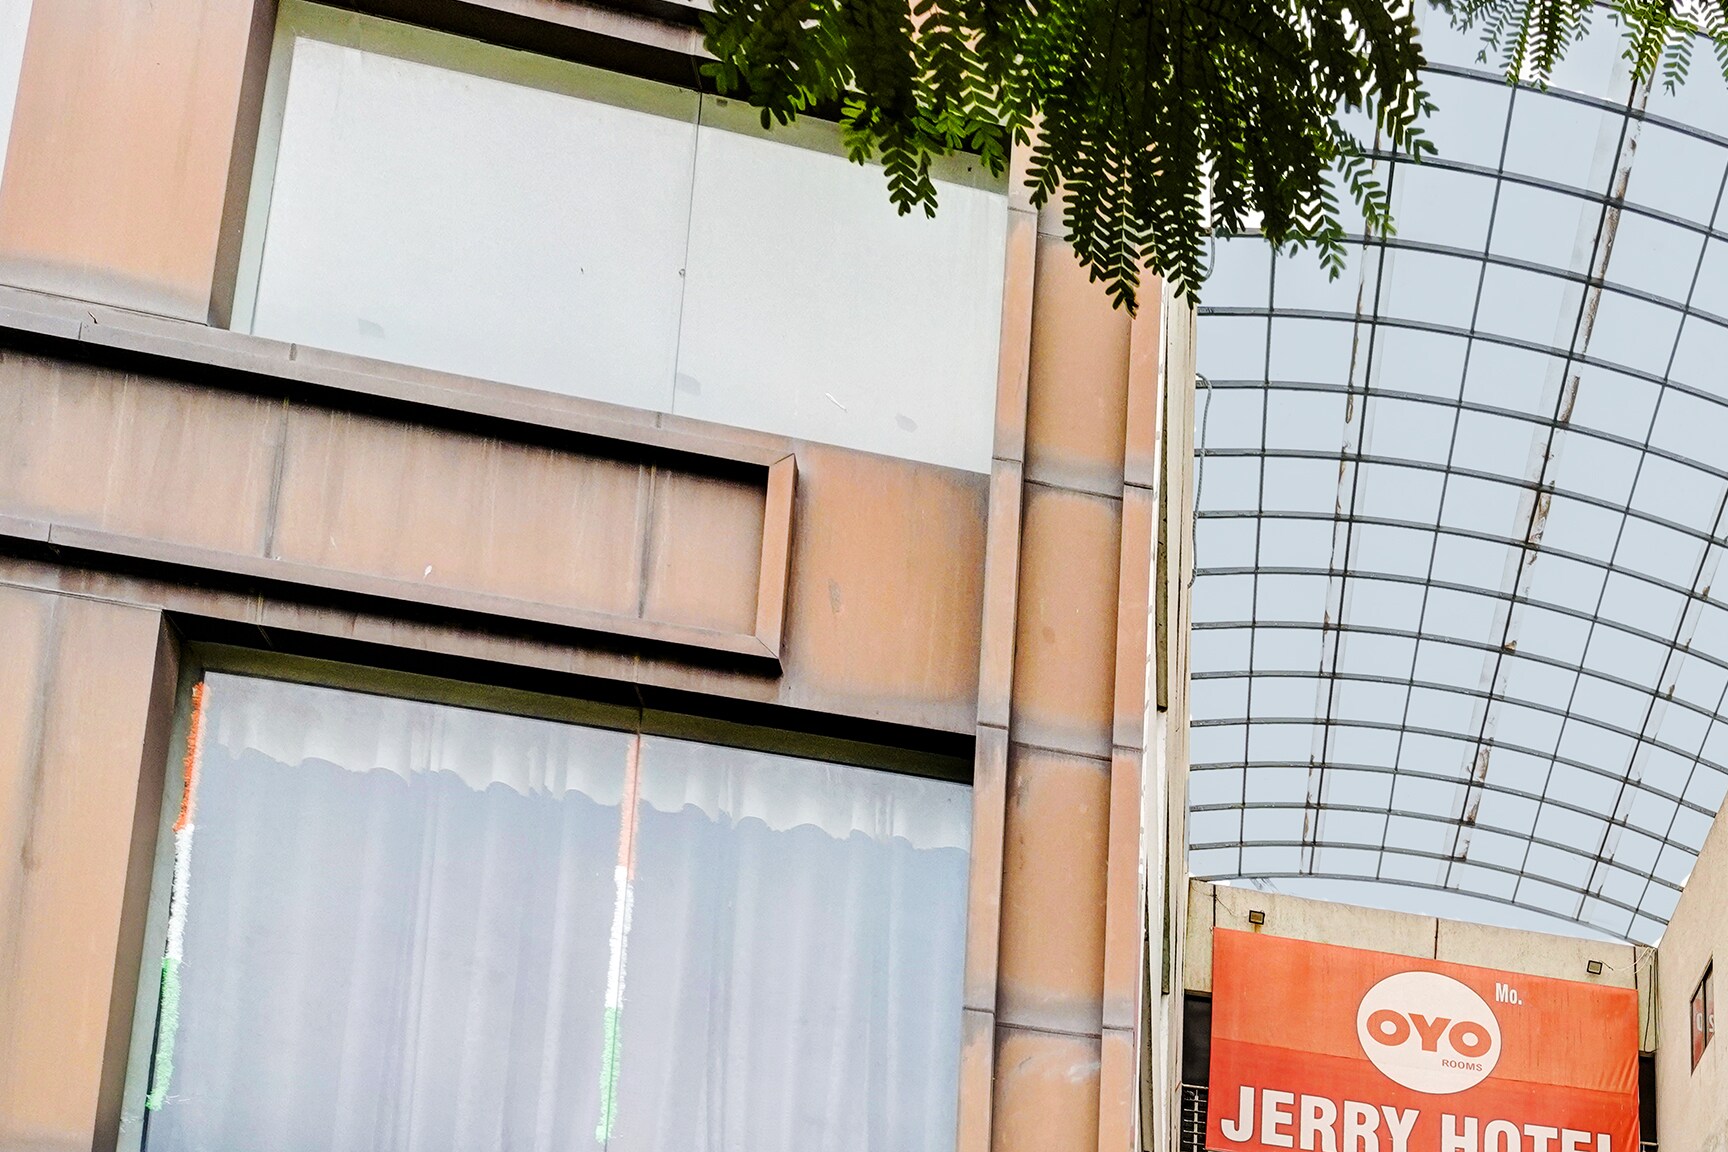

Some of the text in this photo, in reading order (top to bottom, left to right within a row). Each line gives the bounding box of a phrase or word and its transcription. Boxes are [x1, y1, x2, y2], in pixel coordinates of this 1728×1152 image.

[1496, 982, 1523, 1006] Mo.
[1366, 1008, 1492, 1058] OYO
[1441, 1058, 1483, 1073] ROOMS
